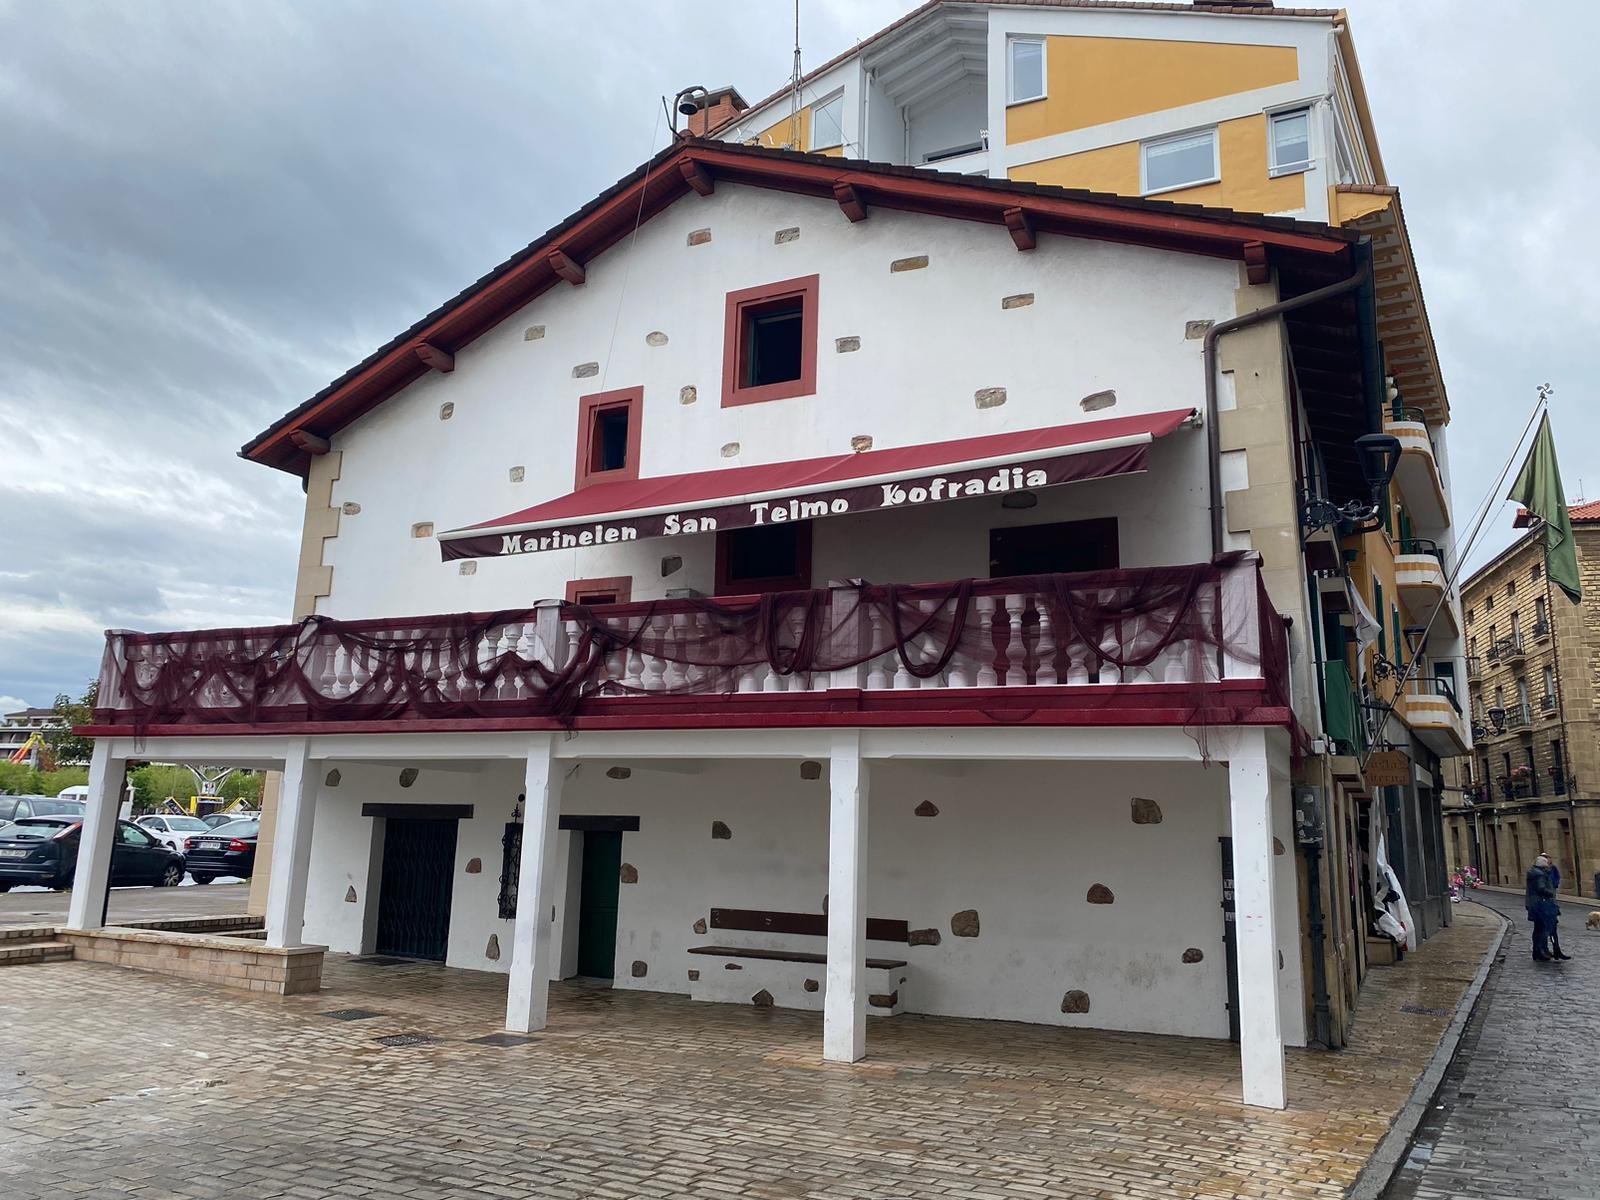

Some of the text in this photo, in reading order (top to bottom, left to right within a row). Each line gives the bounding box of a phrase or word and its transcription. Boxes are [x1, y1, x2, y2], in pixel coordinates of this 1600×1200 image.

[500, 467, 1047, 555] Marinelen San Telmo Kofradia
